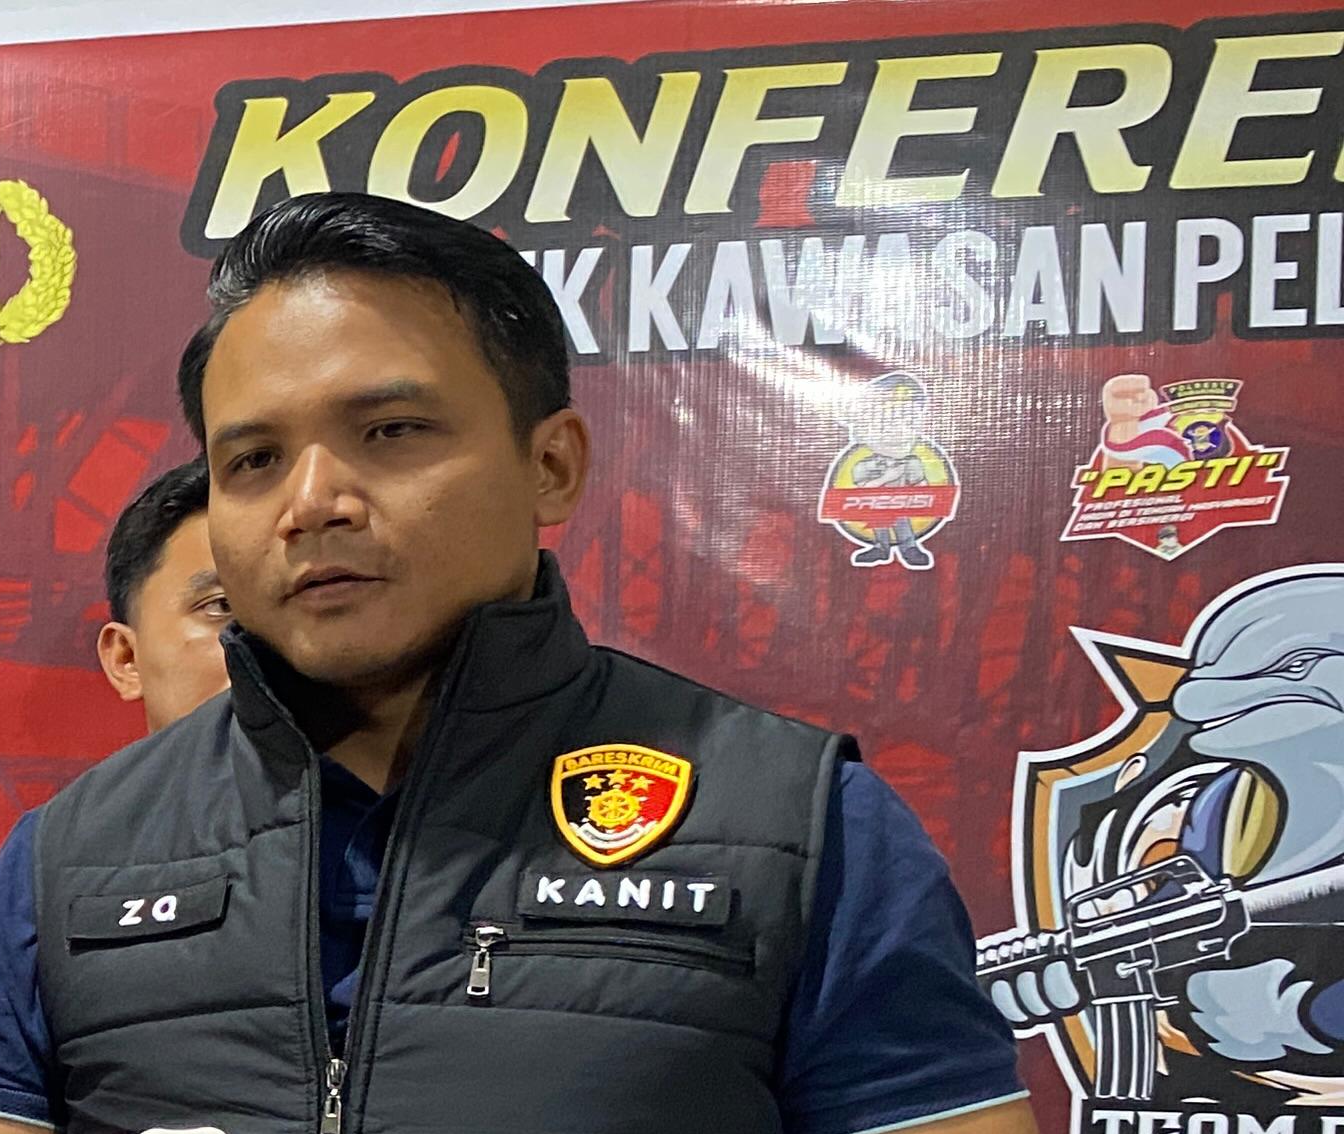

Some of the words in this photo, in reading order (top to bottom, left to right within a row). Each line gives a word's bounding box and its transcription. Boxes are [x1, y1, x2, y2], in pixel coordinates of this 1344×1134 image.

[205, 31, 1344, 239] KONFERE
[519, 247, 606, 354] K
[628, 222, 1146, 352] KAWASAN
[842, 494, 936, 511] PRESISI
[565, 752, 679, 774] BARESKRIM
[537, 876, 718, 912] KANIT
